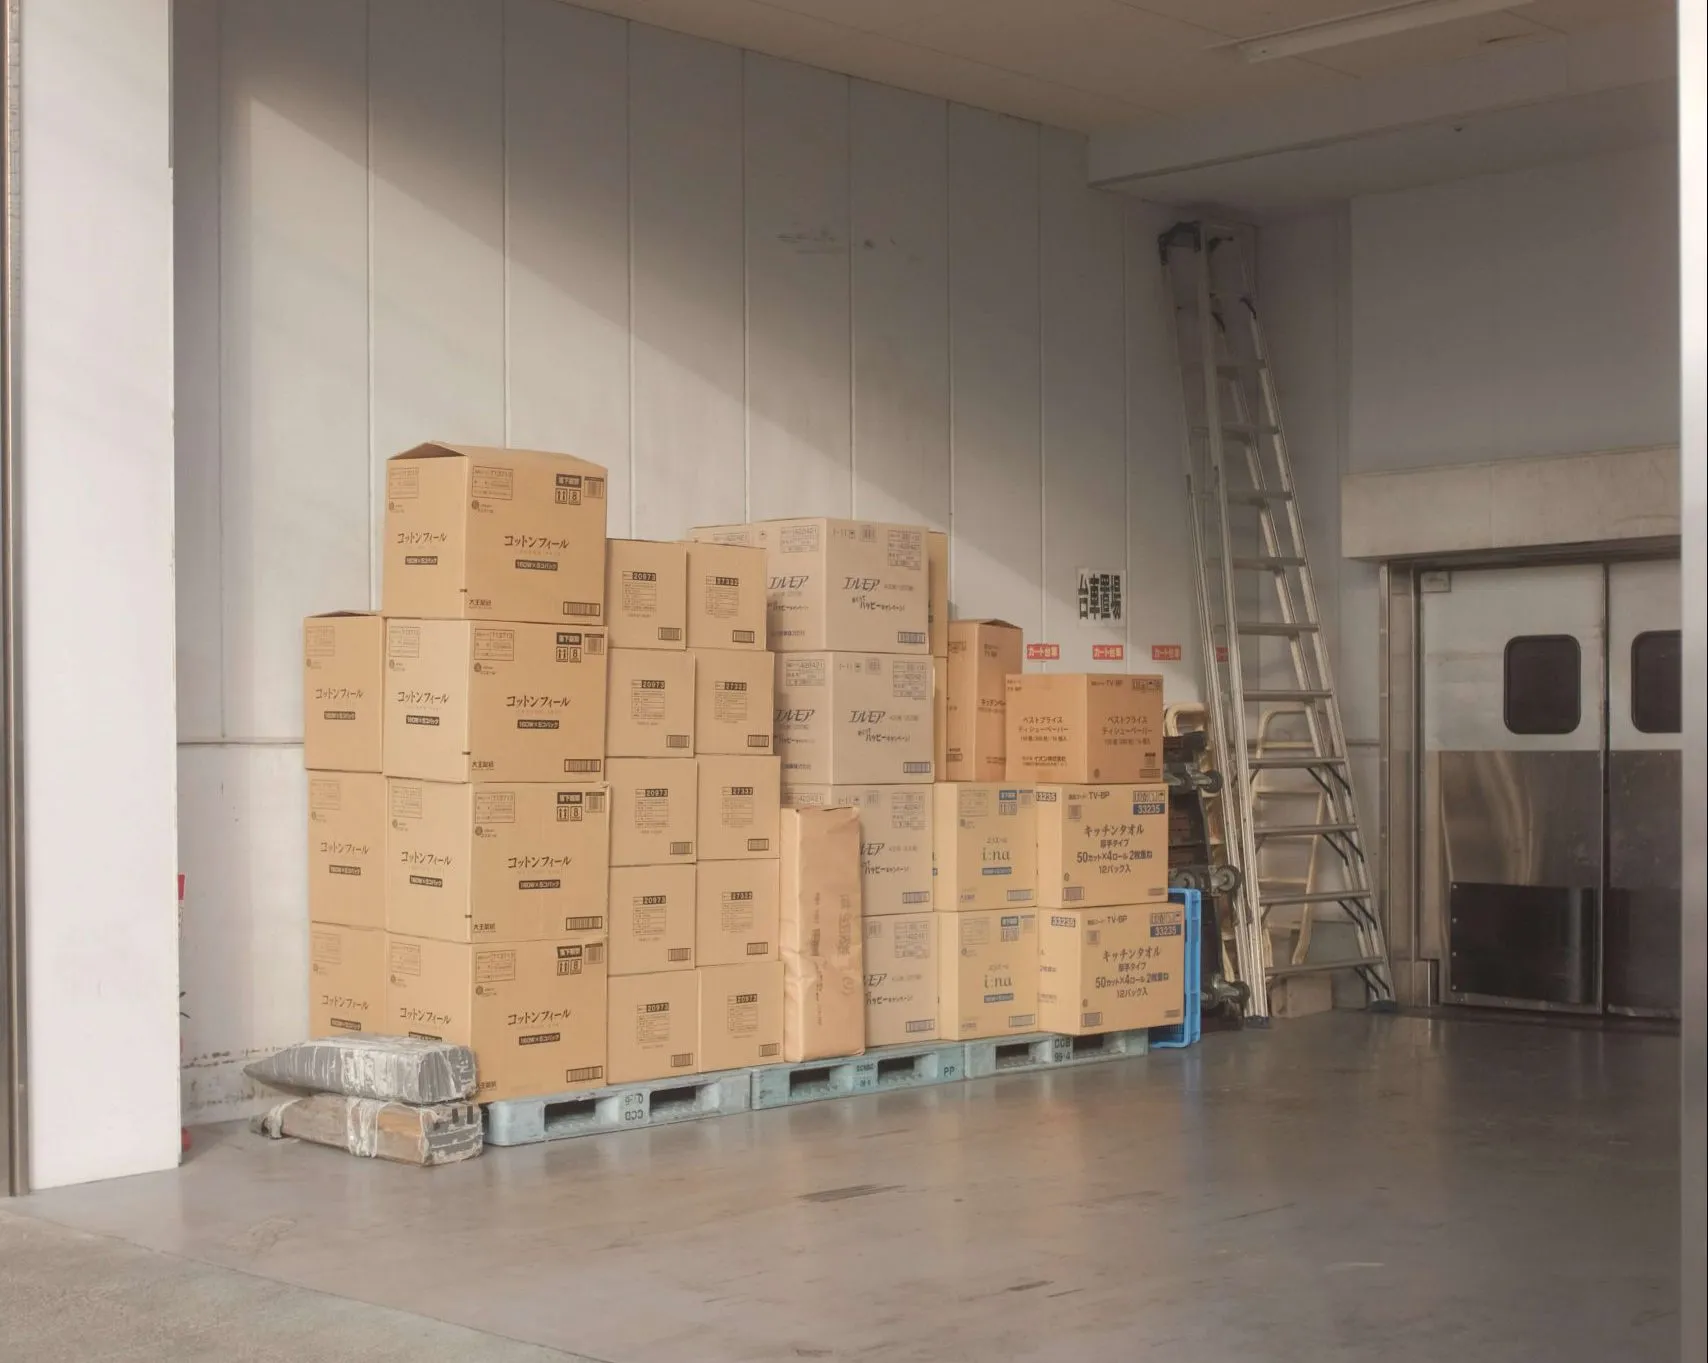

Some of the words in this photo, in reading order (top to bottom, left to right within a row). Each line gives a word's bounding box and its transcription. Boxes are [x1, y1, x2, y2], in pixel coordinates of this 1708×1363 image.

[397, 531, 447, 545] コットンフィール
[504, 534, 569, 550] コットンフィール
[768, 575, 808, 590] エルモア
[842, 576, 880, 592] エルモア
[315, 688, 364, 699] コットンフィール
[398, 690, 449, 704] コットンフィール
[506, 694, 571, 708] コットンフィール
[849, 709, 886, 724] エルモア
[1023, 716, 1063, 724] ベストプライス
[1137, 804, 1160, 814] 33235
[1084, 824, 1144, 837] キッチンタオル
[320, 842, 369, 854] コットンフィール
[860, 842, 886, 857] モア
[401, 851, 452, 865] コットンフィール
[507, 855, 572, 869] コットンフィール
[1099, 864, 1131, 874] 12パック入
[1103, 946, 1160, 962] キッチンタオル
[322, 995, 369, 1010] コットンフィール
[400, 1007, 452, 1025] コットンフィール
[507, 1009, 572, 1026] コットンフィール
[944, 1066, 955, 1076] PP
